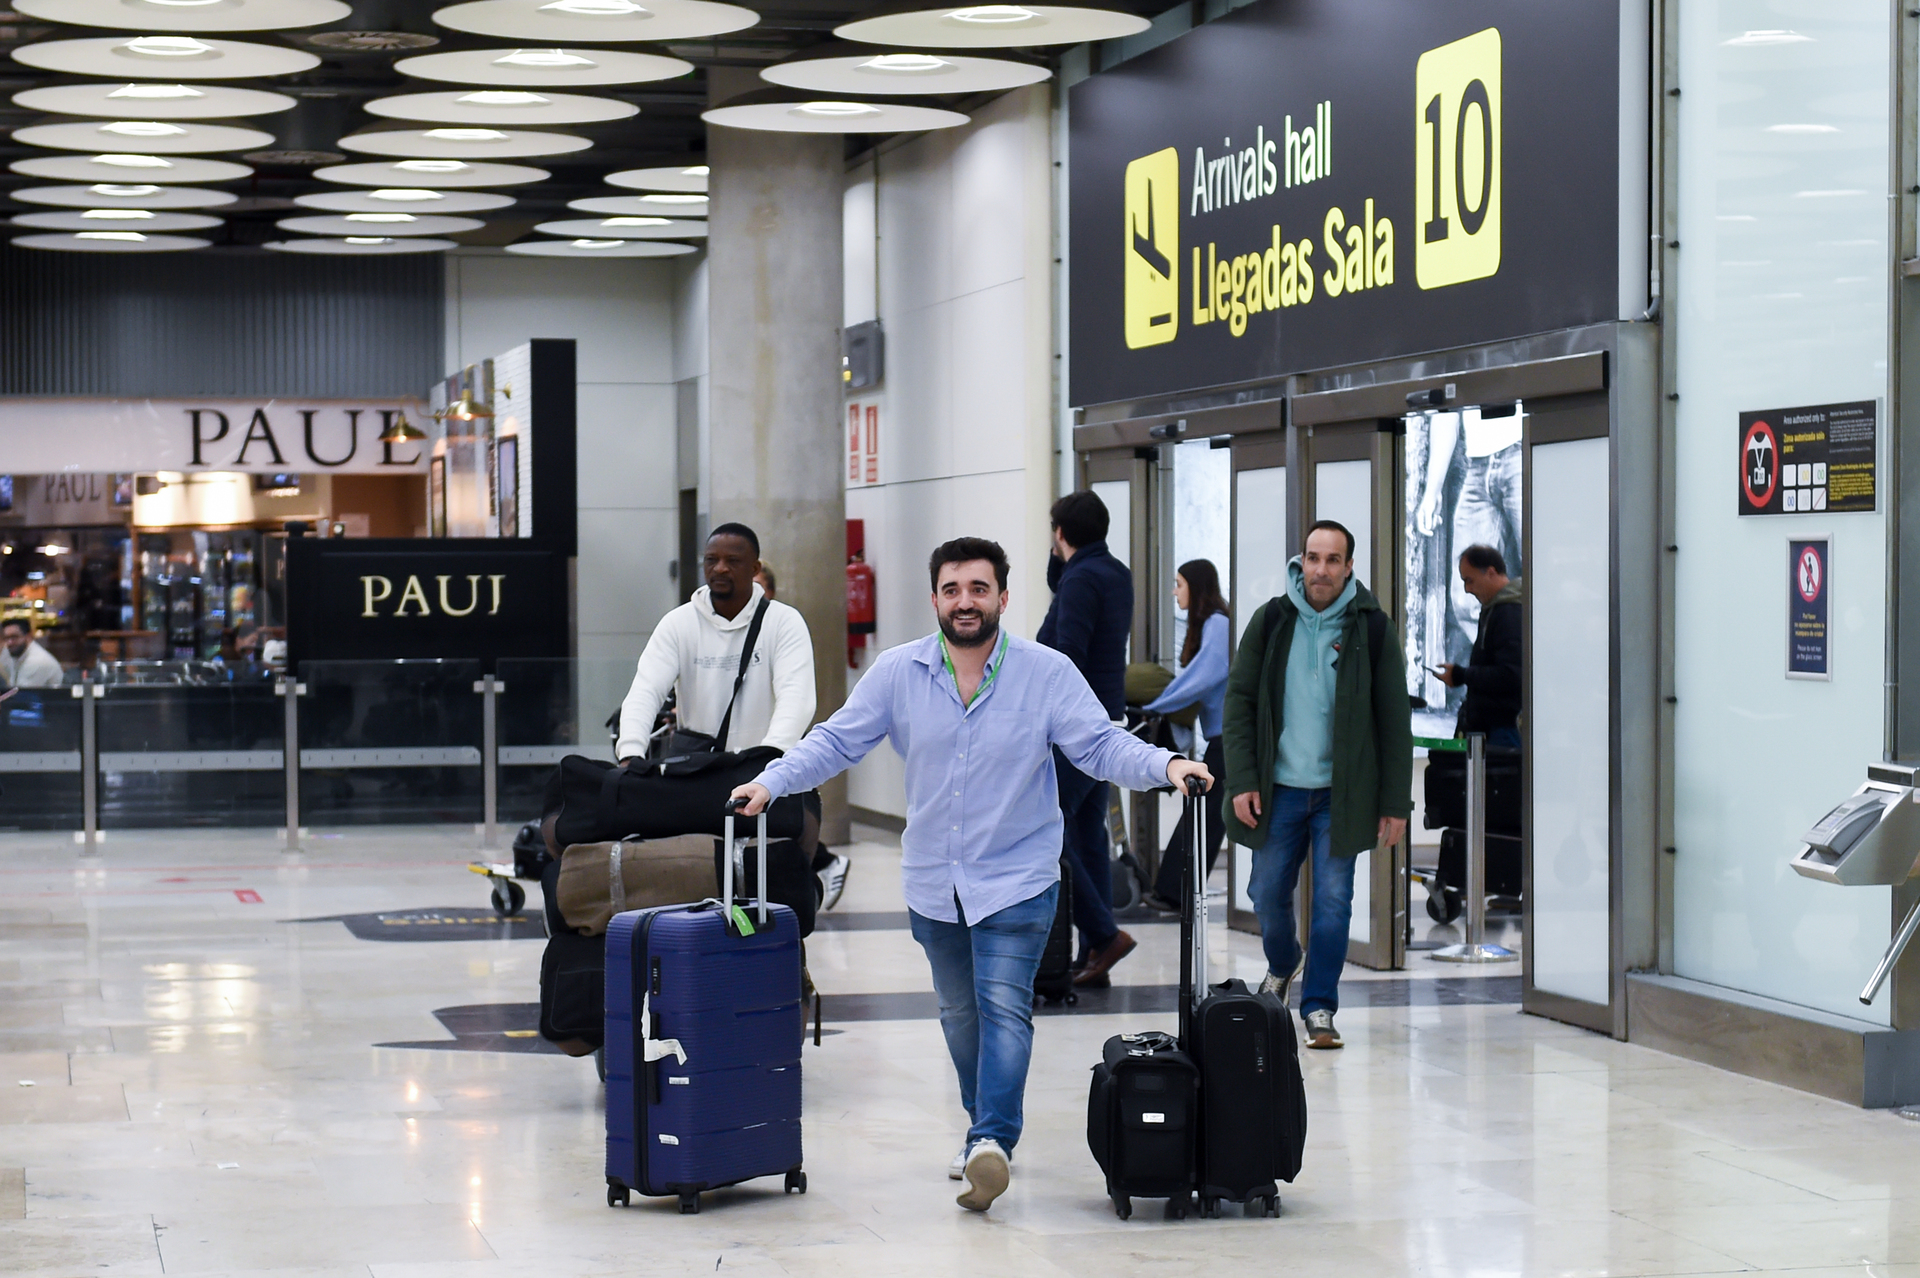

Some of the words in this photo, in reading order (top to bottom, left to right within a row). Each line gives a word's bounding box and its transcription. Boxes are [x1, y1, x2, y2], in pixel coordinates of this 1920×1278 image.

[1191, 124, 1278, 217] Arrivals
[1285, 100, 1332, 189] hall
[1423, 78, 1494, 245] 10
[1192, 224, 1314, 338] Llegadas
[1323, 198, 1395, 298] Sala
[184, 408, 422, 466] PAUL
